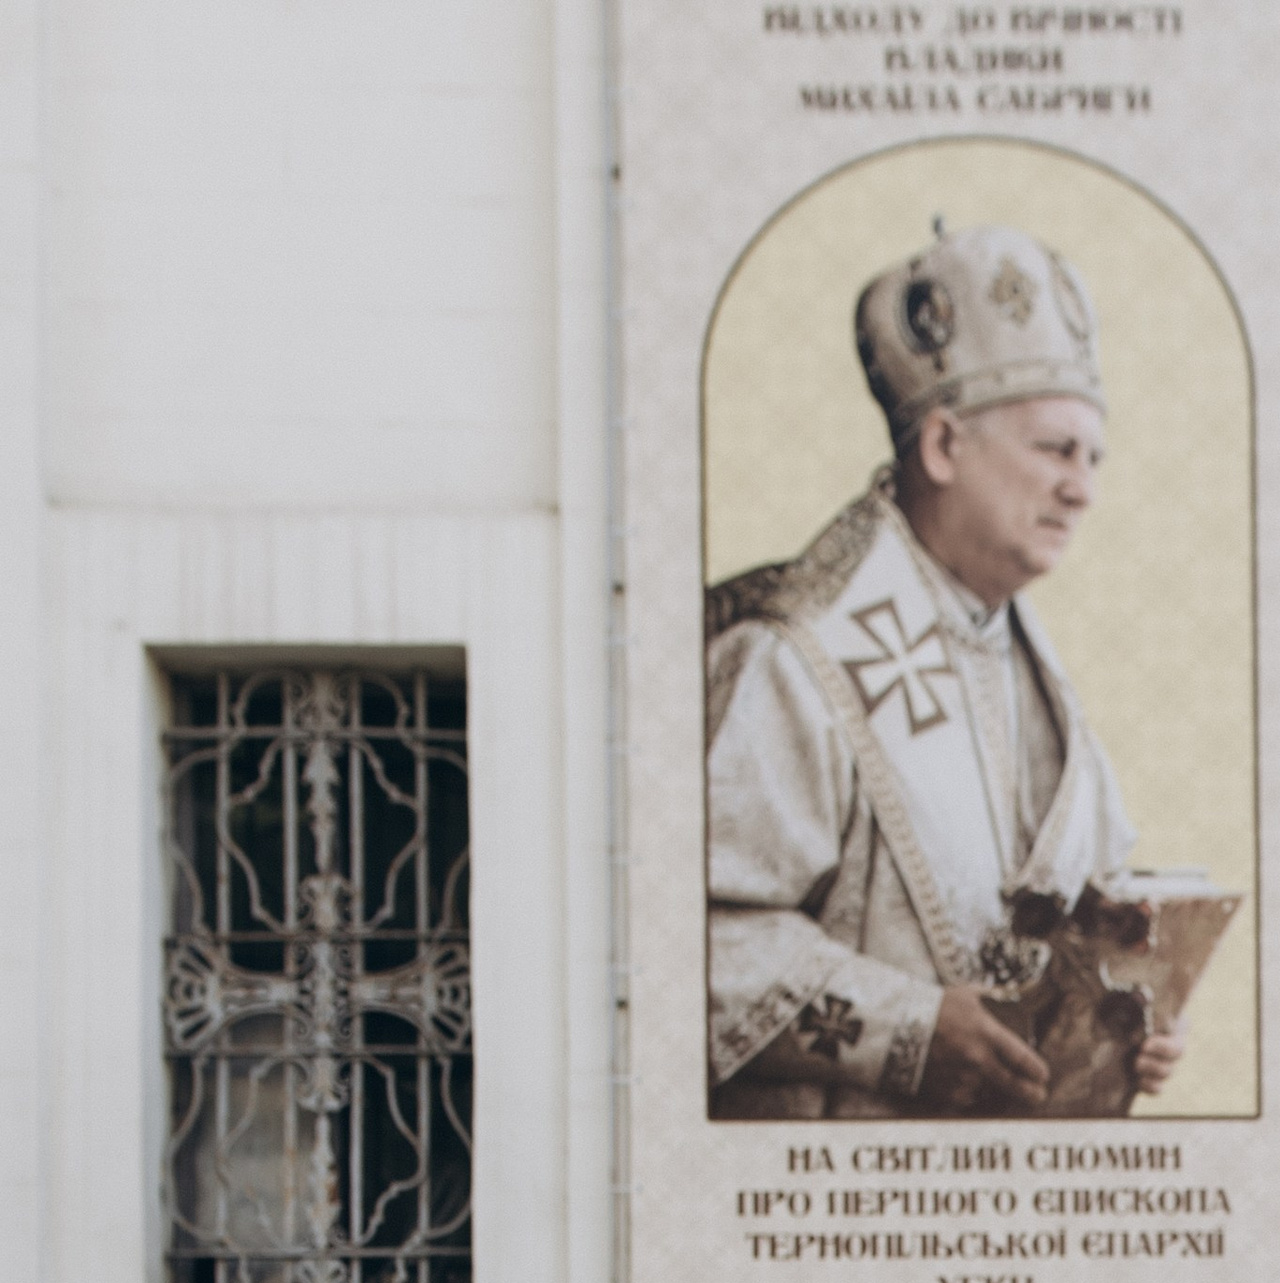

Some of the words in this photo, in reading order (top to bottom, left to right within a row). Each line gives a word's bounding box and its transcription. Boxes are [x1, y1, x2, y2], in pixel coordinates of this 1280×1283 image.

[786, 1143, 837, 1174] НА
[850, 1140, 1013, 1174] СВІТЛИЙ
[1025, 1143, 1184, 1173] СПОМИН
[735, 1187, 813, 1218] ПРО
[825, 1186, 1019, 1218] ПЕРШОГО
[1031, 1186, 1232, 1217] ЄПИСКОПА
[744, 1226, 1068, 1262] ТЕРНОПІЛЬСЬКОЇ
[1080, 1226, 1226, 1260] ЄПАРХІЇ
